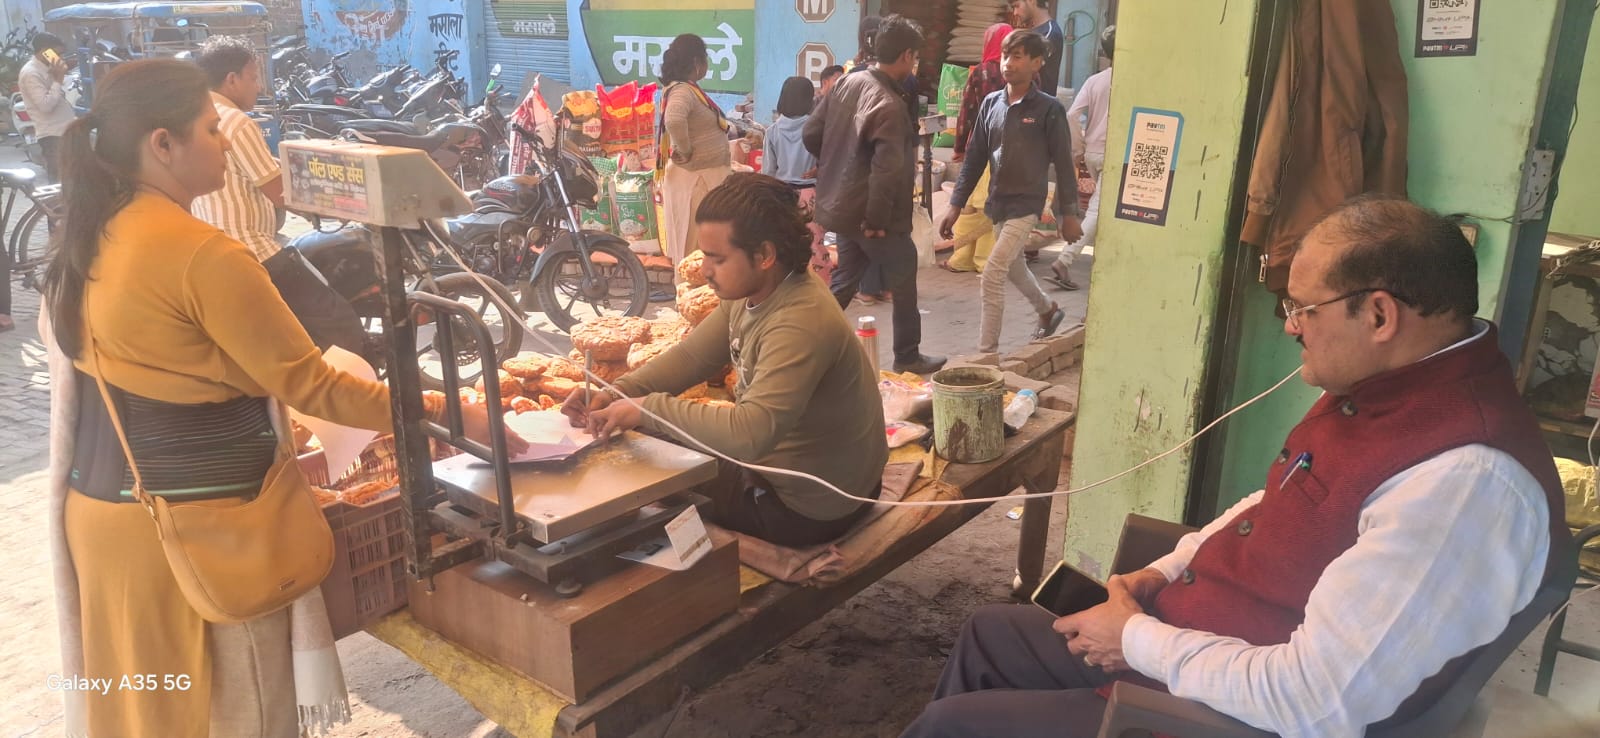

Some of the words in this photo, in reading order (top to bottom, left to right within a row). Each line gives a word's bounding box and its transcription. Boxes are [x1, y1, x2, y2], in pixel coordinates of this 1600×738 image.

[428, 13, 464, 42] मसाला
[512, 13, 557, 35] मसाले
[804, 50, 829, 88] B
[308, 156, 327, 179] पॉल
